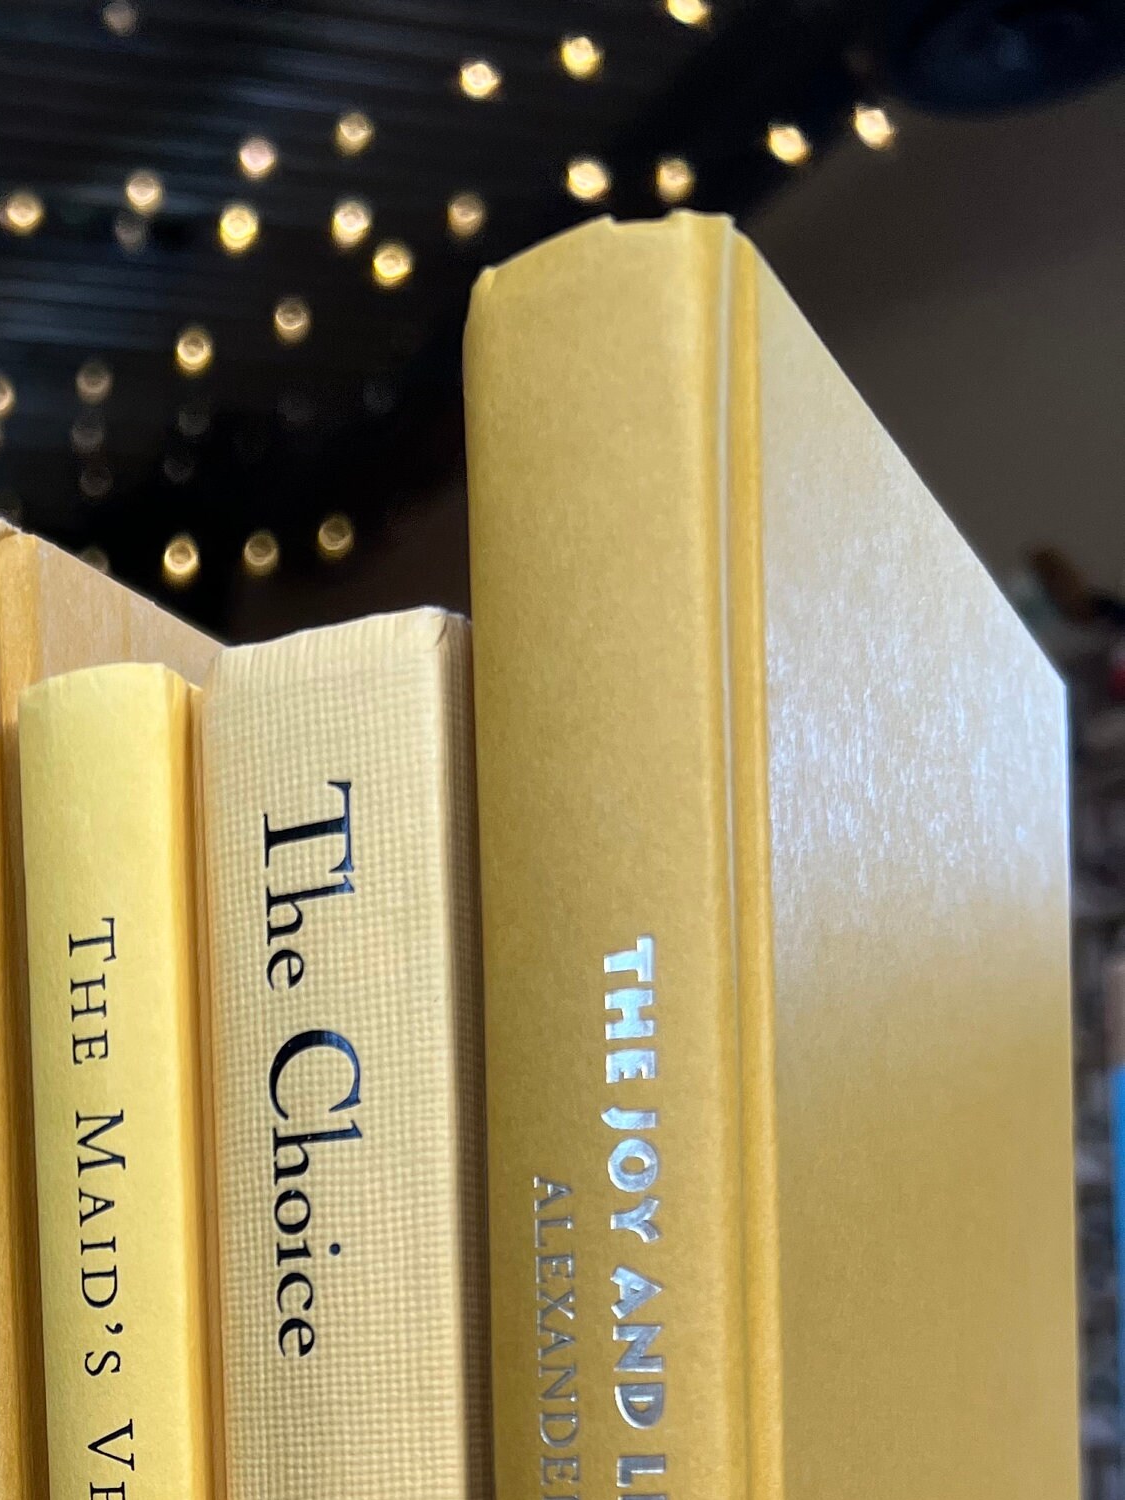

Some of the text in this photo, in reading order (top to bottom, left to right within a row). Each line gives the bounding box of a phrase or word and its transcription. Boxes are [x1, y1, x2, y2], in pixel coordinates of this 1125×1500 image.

[263, 780, 356, 991] The
[68, 916, 117, 1067] THE
[603, 934, 656, 1084] THE
[268, 1028, 364, 1359] Choice
[600, 1106, 660, 1244] JOY
[610, 1265, 666, 1430] AND
